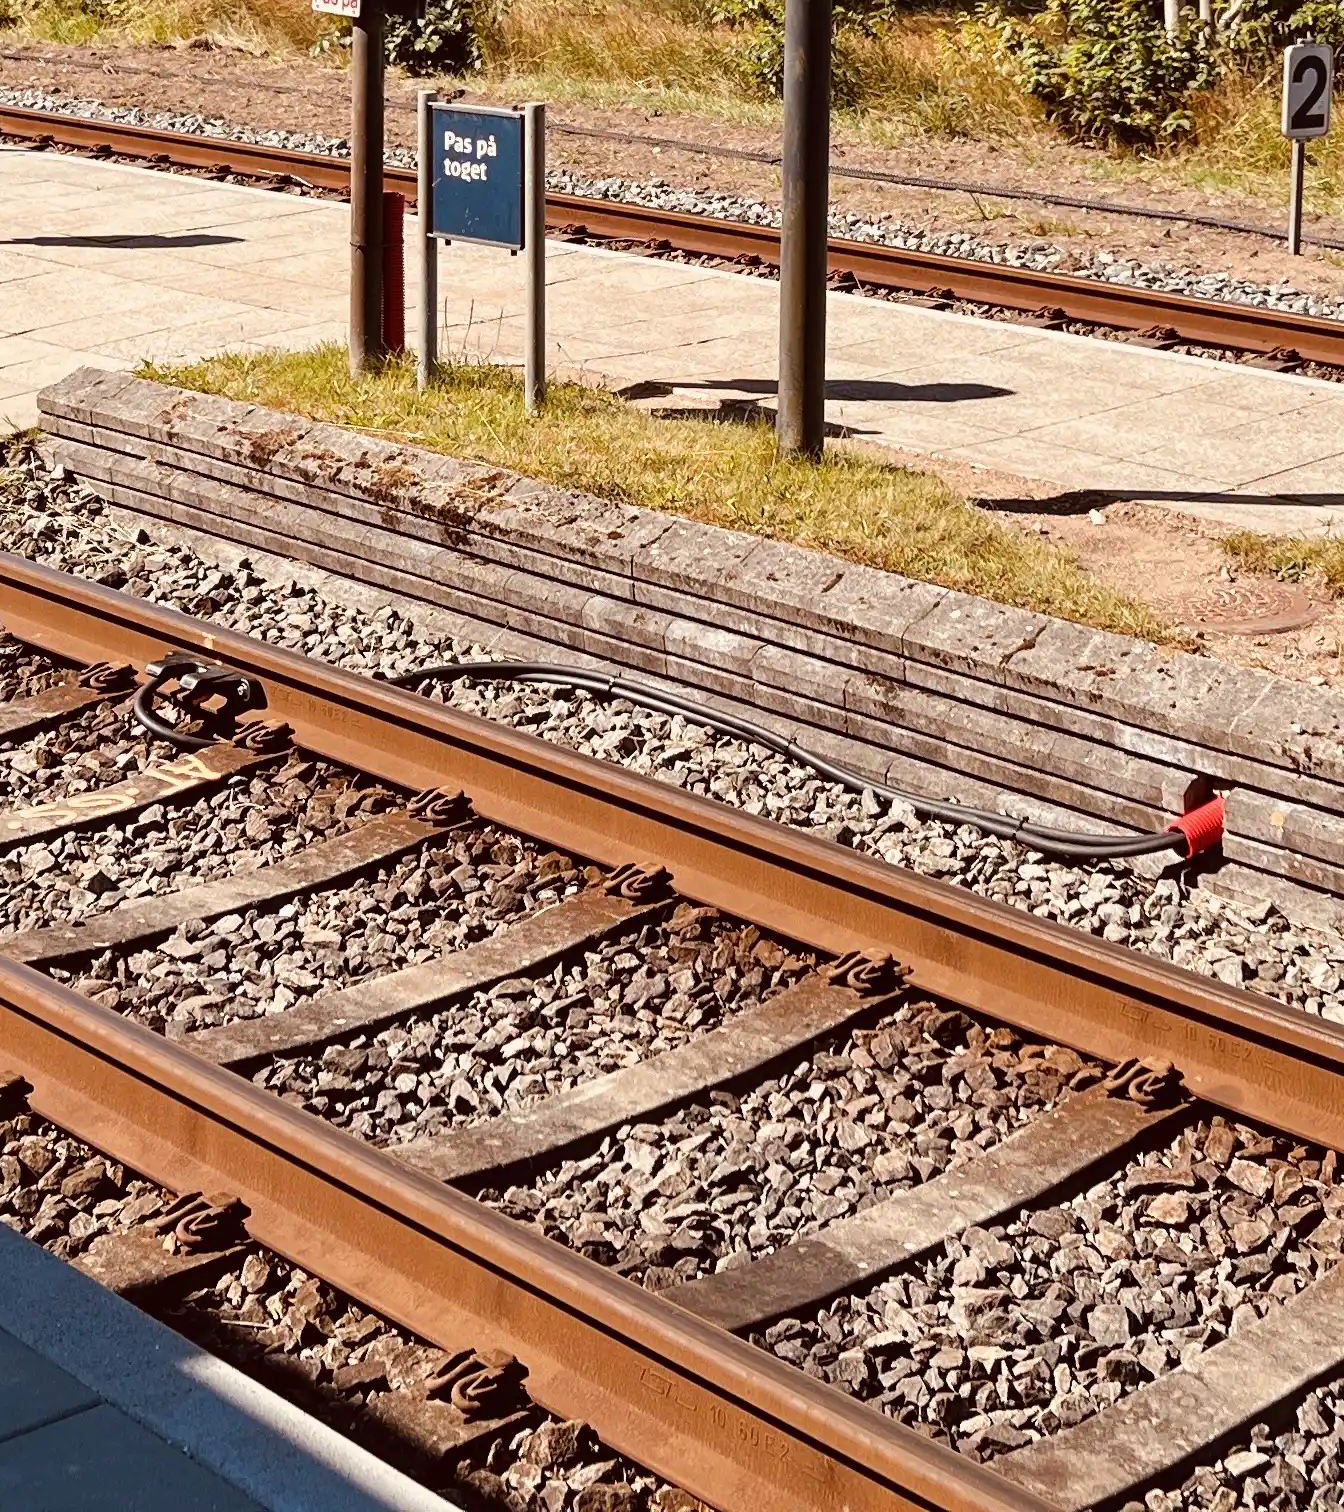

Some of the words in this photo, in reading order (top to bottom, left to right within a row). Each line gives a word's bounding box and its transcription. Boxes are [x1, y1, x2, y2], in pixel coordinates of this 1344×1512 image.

[1290, 54, 1328, 130] 2
[444, 130, 473, 154] Pas
[476, 134, 497, 160] på
[443, 157, 488, 183] toget
